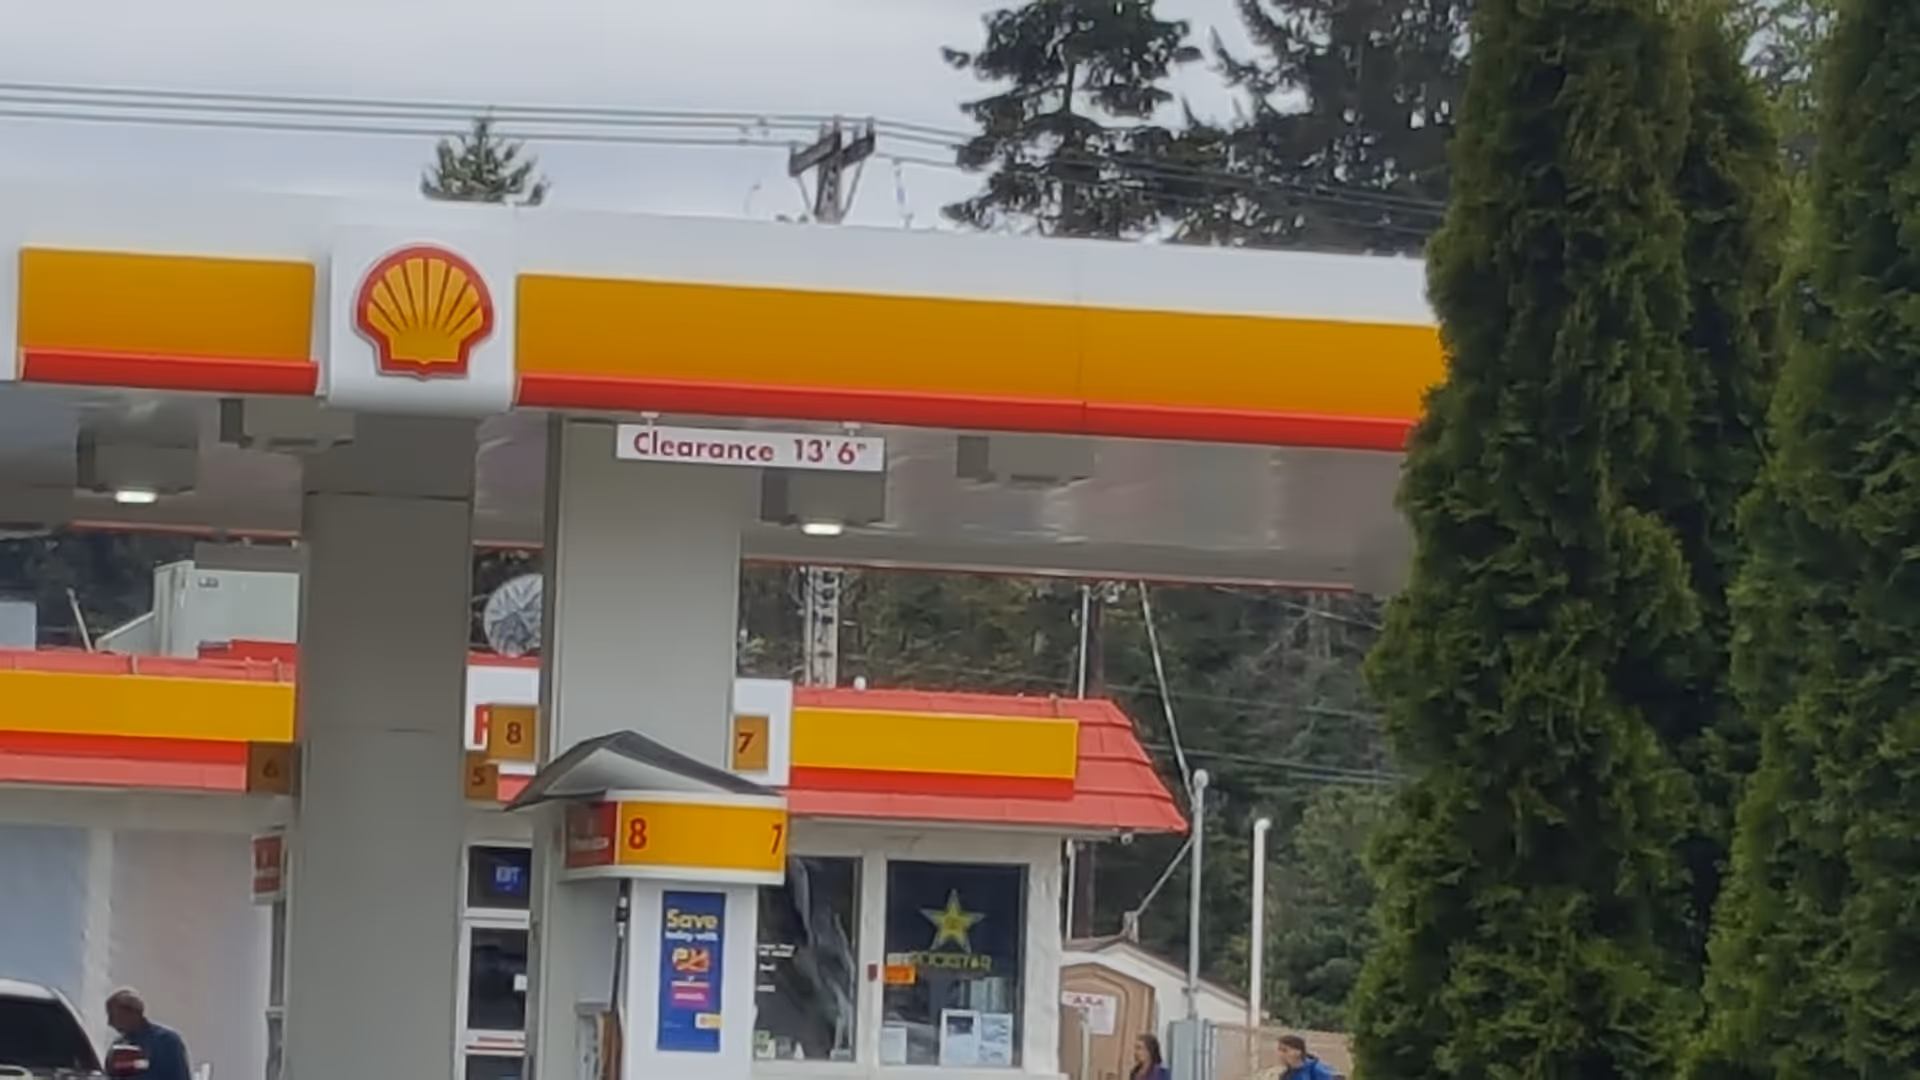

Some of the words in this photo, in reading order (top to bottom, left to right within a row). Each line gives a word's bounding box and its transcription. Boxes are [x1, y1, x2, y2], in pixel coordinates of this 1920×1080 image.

[633, 430, 774, 462] Clearance
[506, 721, 522, 744] 8
[738, 732, 754, 754] 7
[262, 759, 279, 778] 6
[472, 766, 486, 786] 5
[628, 817, 647, 850] 8
[771, 823, 783, 854] 7
[667, 908, 718, 929] Save
